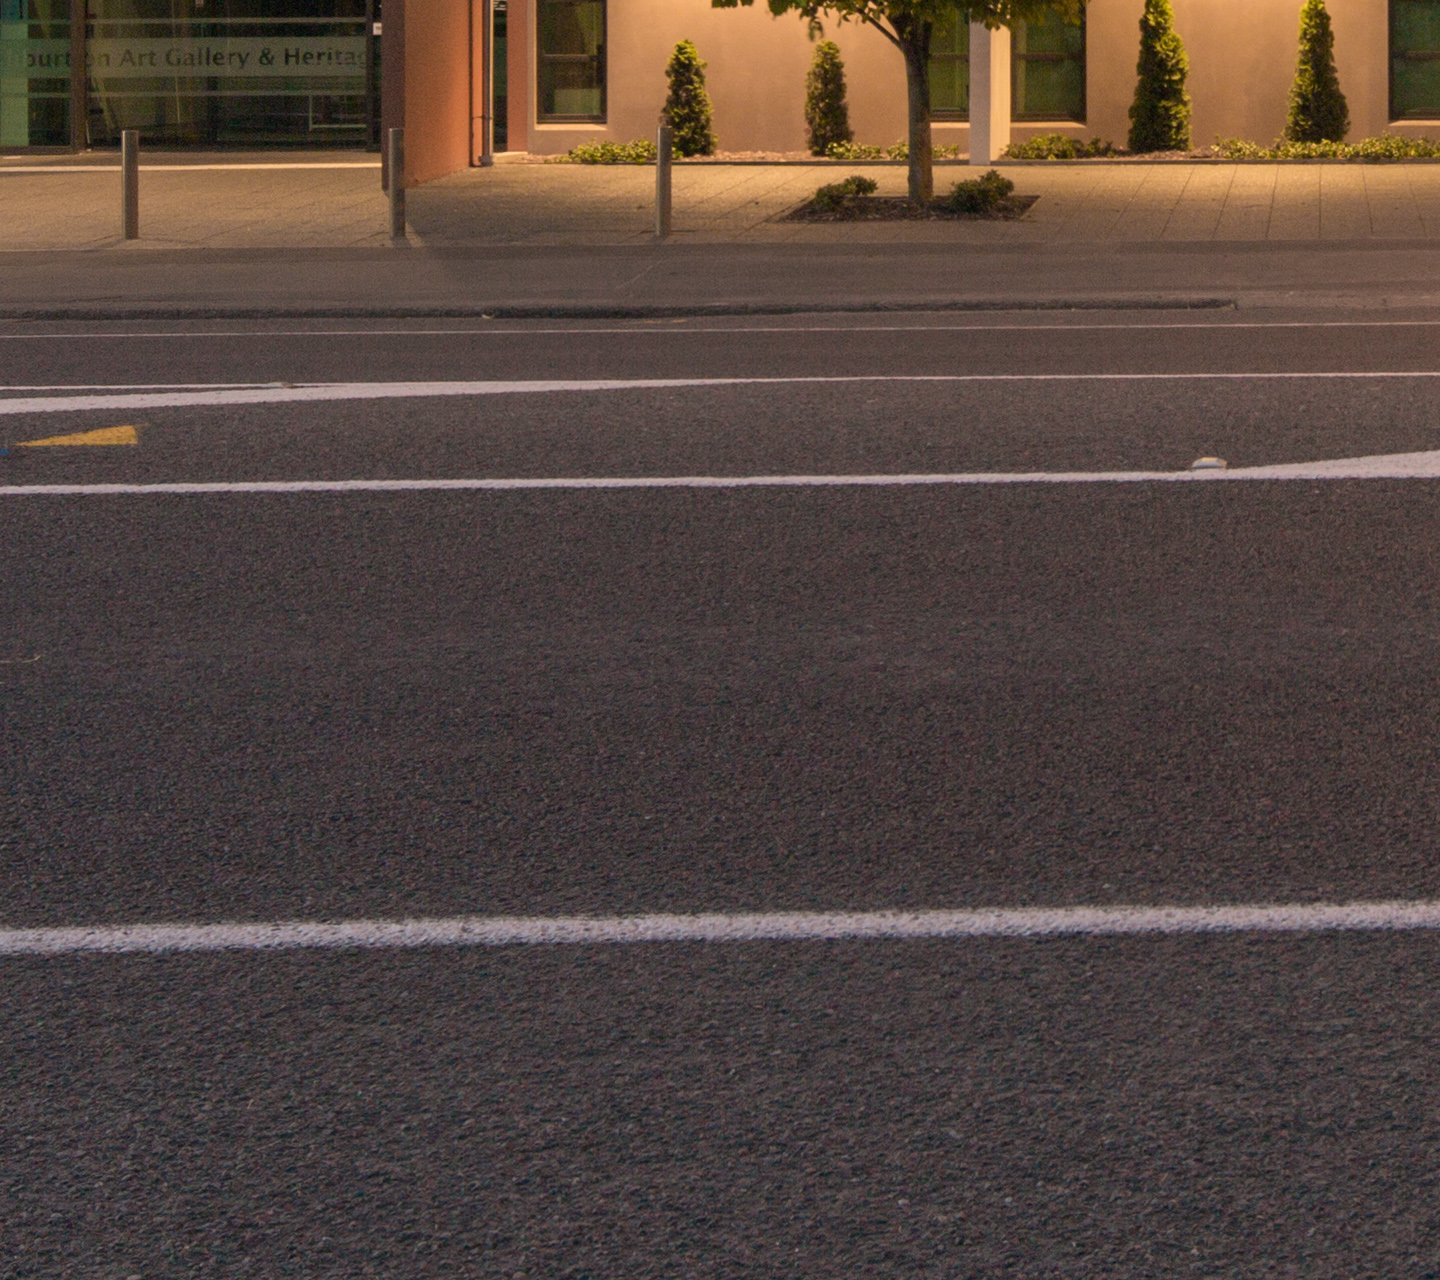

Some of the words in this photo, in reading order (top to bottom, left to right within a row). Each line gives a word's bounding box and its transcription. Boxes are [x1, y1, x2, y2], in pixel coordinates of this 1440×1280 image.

[120, 48, 157, 67] Art
[165, 46, 250, 69] Gallery
[258, 47, 275, 66] &
